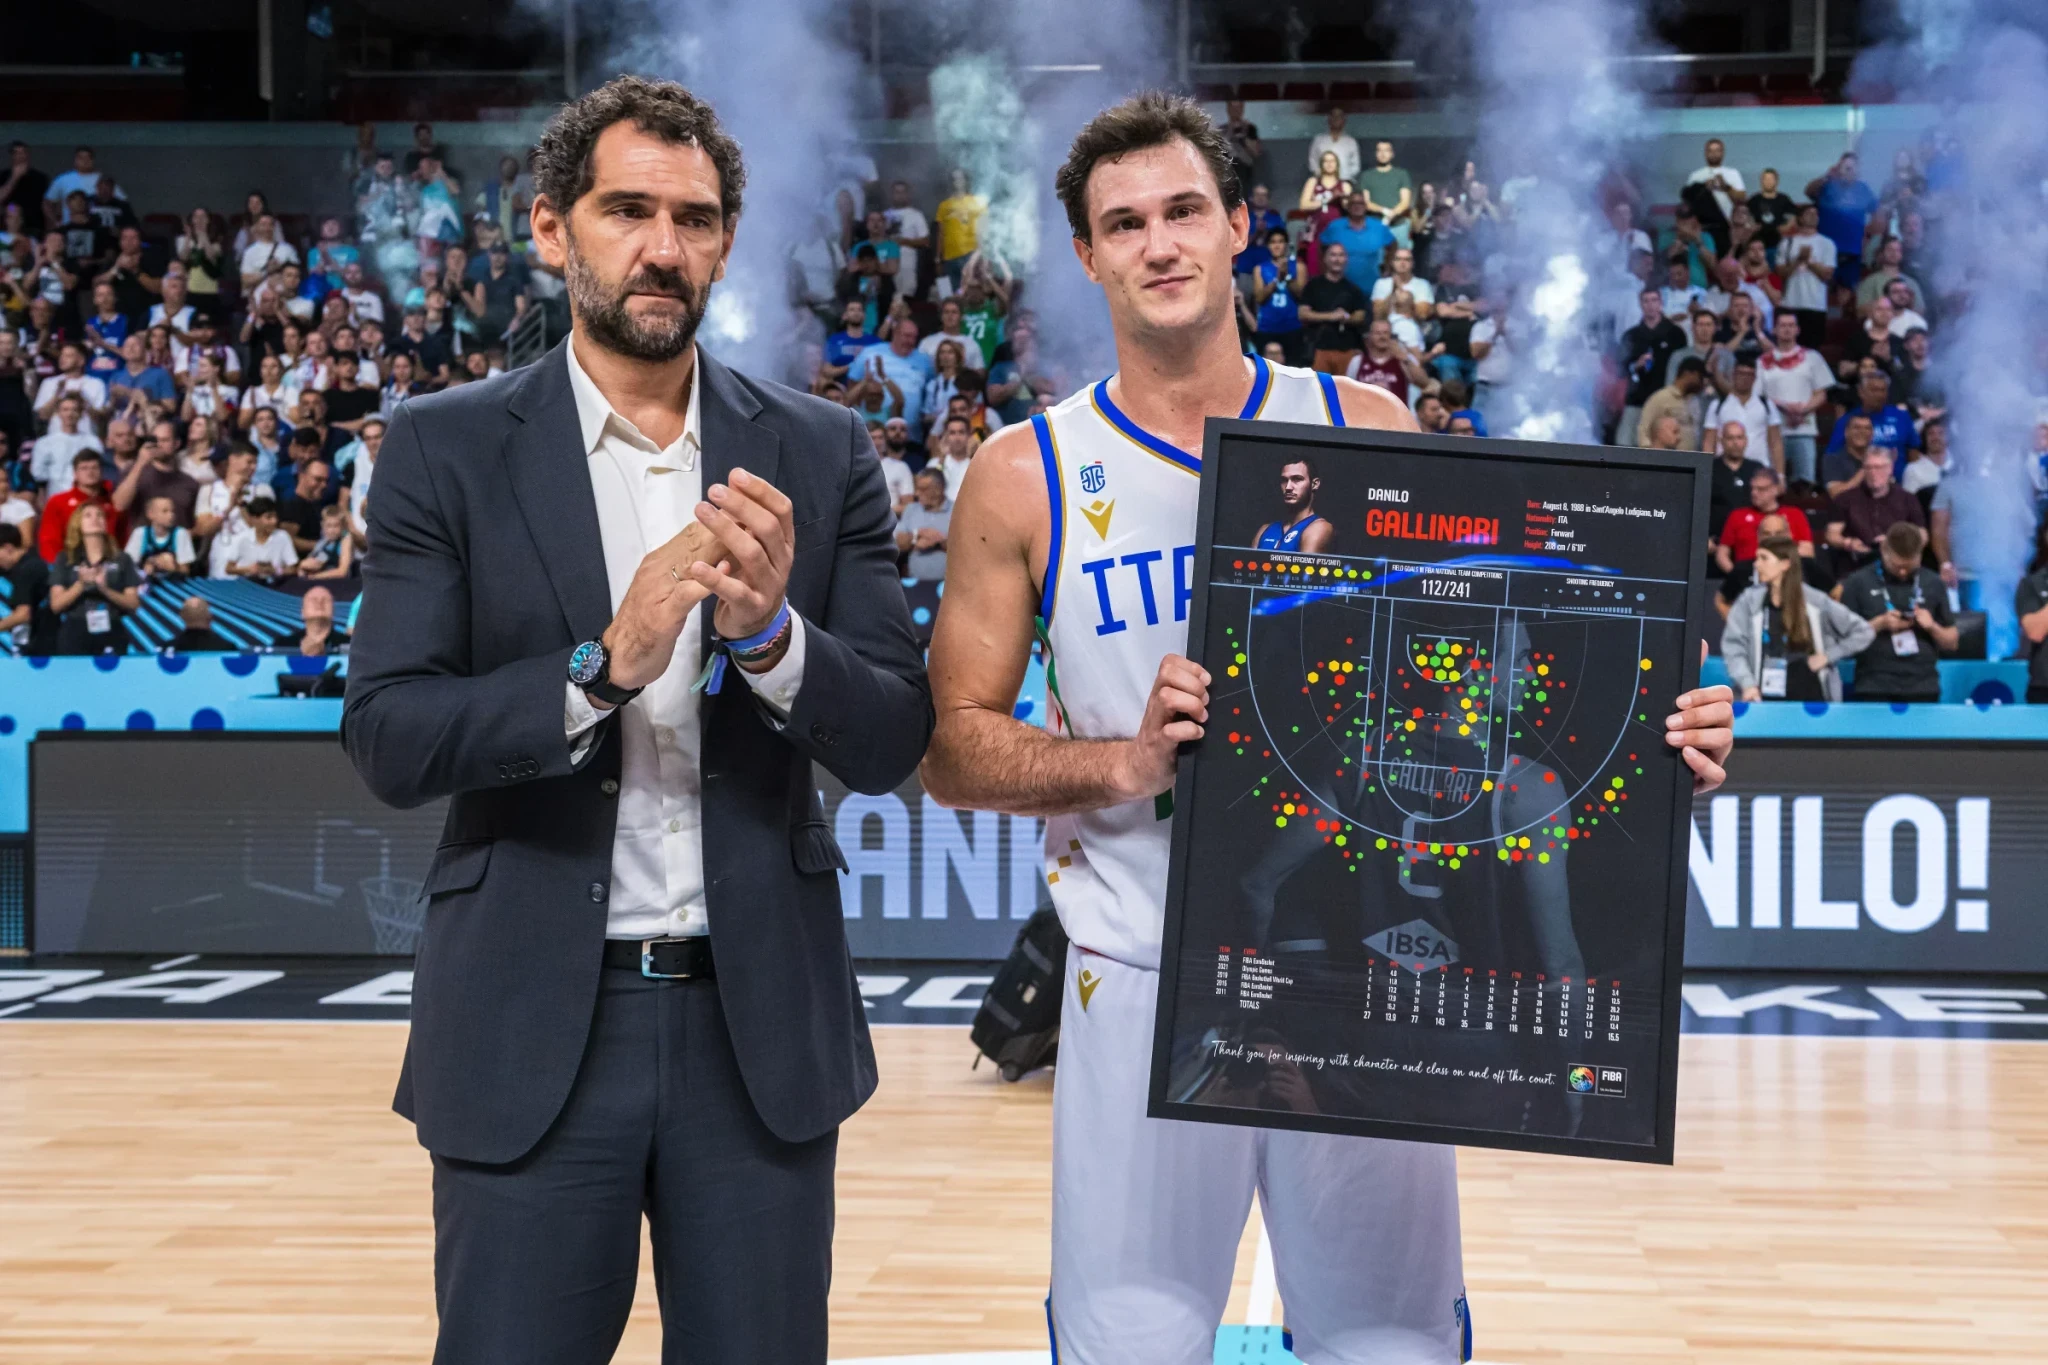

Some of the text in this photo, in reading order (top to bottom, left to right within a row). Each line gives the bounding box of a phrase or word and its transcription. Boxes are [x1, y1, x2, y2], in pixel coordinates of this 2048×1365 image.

[1367, 488, 1409, 503] DANILO
[1543, 501, 1562, 512] August
[1563, 503, 1568, 512] 8,
[1571, 503, 1584, 512] 1988
[1586, 504, 1591, 512] in
[1654, 509, 1666, 519] Italy
[1526, 514, 1568, 525] Nationality: ITA
[1366, 509, 1499, 545] GALLINARI
[1525, 526, 1574, 538] Position: Forward
[1524, 540, 1543, 550] Height:
[1545, 541, 1556, 550] 208
[1270, 554, 1292, 562] SHOOTING
[1292, 556, 1315, 564] EFFICIENCY
[1436, 568, 1457, 576] NATIONAL
[1472, 571, 1502, 579] COMPETITIONS
[1422, 579, 1470, 597] 112/241
[1589, 579, 1614, 588] FREQUENCY
[1388, 756, 1474, 804] GALLIARI
[1386, 931, 1450, 961] IBSA
[1242, 965, 1258, 974] Olympic
[1240, 1000, 1259, 1009] TOTALS
[1363, 1010, 1371, 1019] 27
[1385, 1012, 1396, 1022] 13.9
[1411, 1015, 1418, 1023] 77
[1436, 1017, 1445, 1026] 143
[1461, 1019, 1468, 1028] 35
[1485, 1022, 1493, 1030] 98
[1509, 1024, 1518, 1032] 116
[1533, 1026, 1543, 1035] 138
[1585, 1030, 1593, 1039] 1.7
[1608, 1032, 1619, 1042] 15.5
[1212, 1040, 1244, 1058] Thank
[1246, 1050, 1265, 1063] you
[1268, 1049, 1281, 1063] for
[1285, 1052, 1325, 1070] inspiring
[1330, 1053, 1350, 1066] with
[1354, 1055, 1399, 1070] character
[1402, 1061, 1423, 1073] and
[1426, 1062, 1448, 1075] class
[1469, 1067, 1489, 1079] and
[1493, 1070, 1505, 1084] off
[1506, 1069, 1525, 1081] the
[1529, 1073, 1556, 1085] court.
[1602, 1071, 1621, 1082] FIBA
